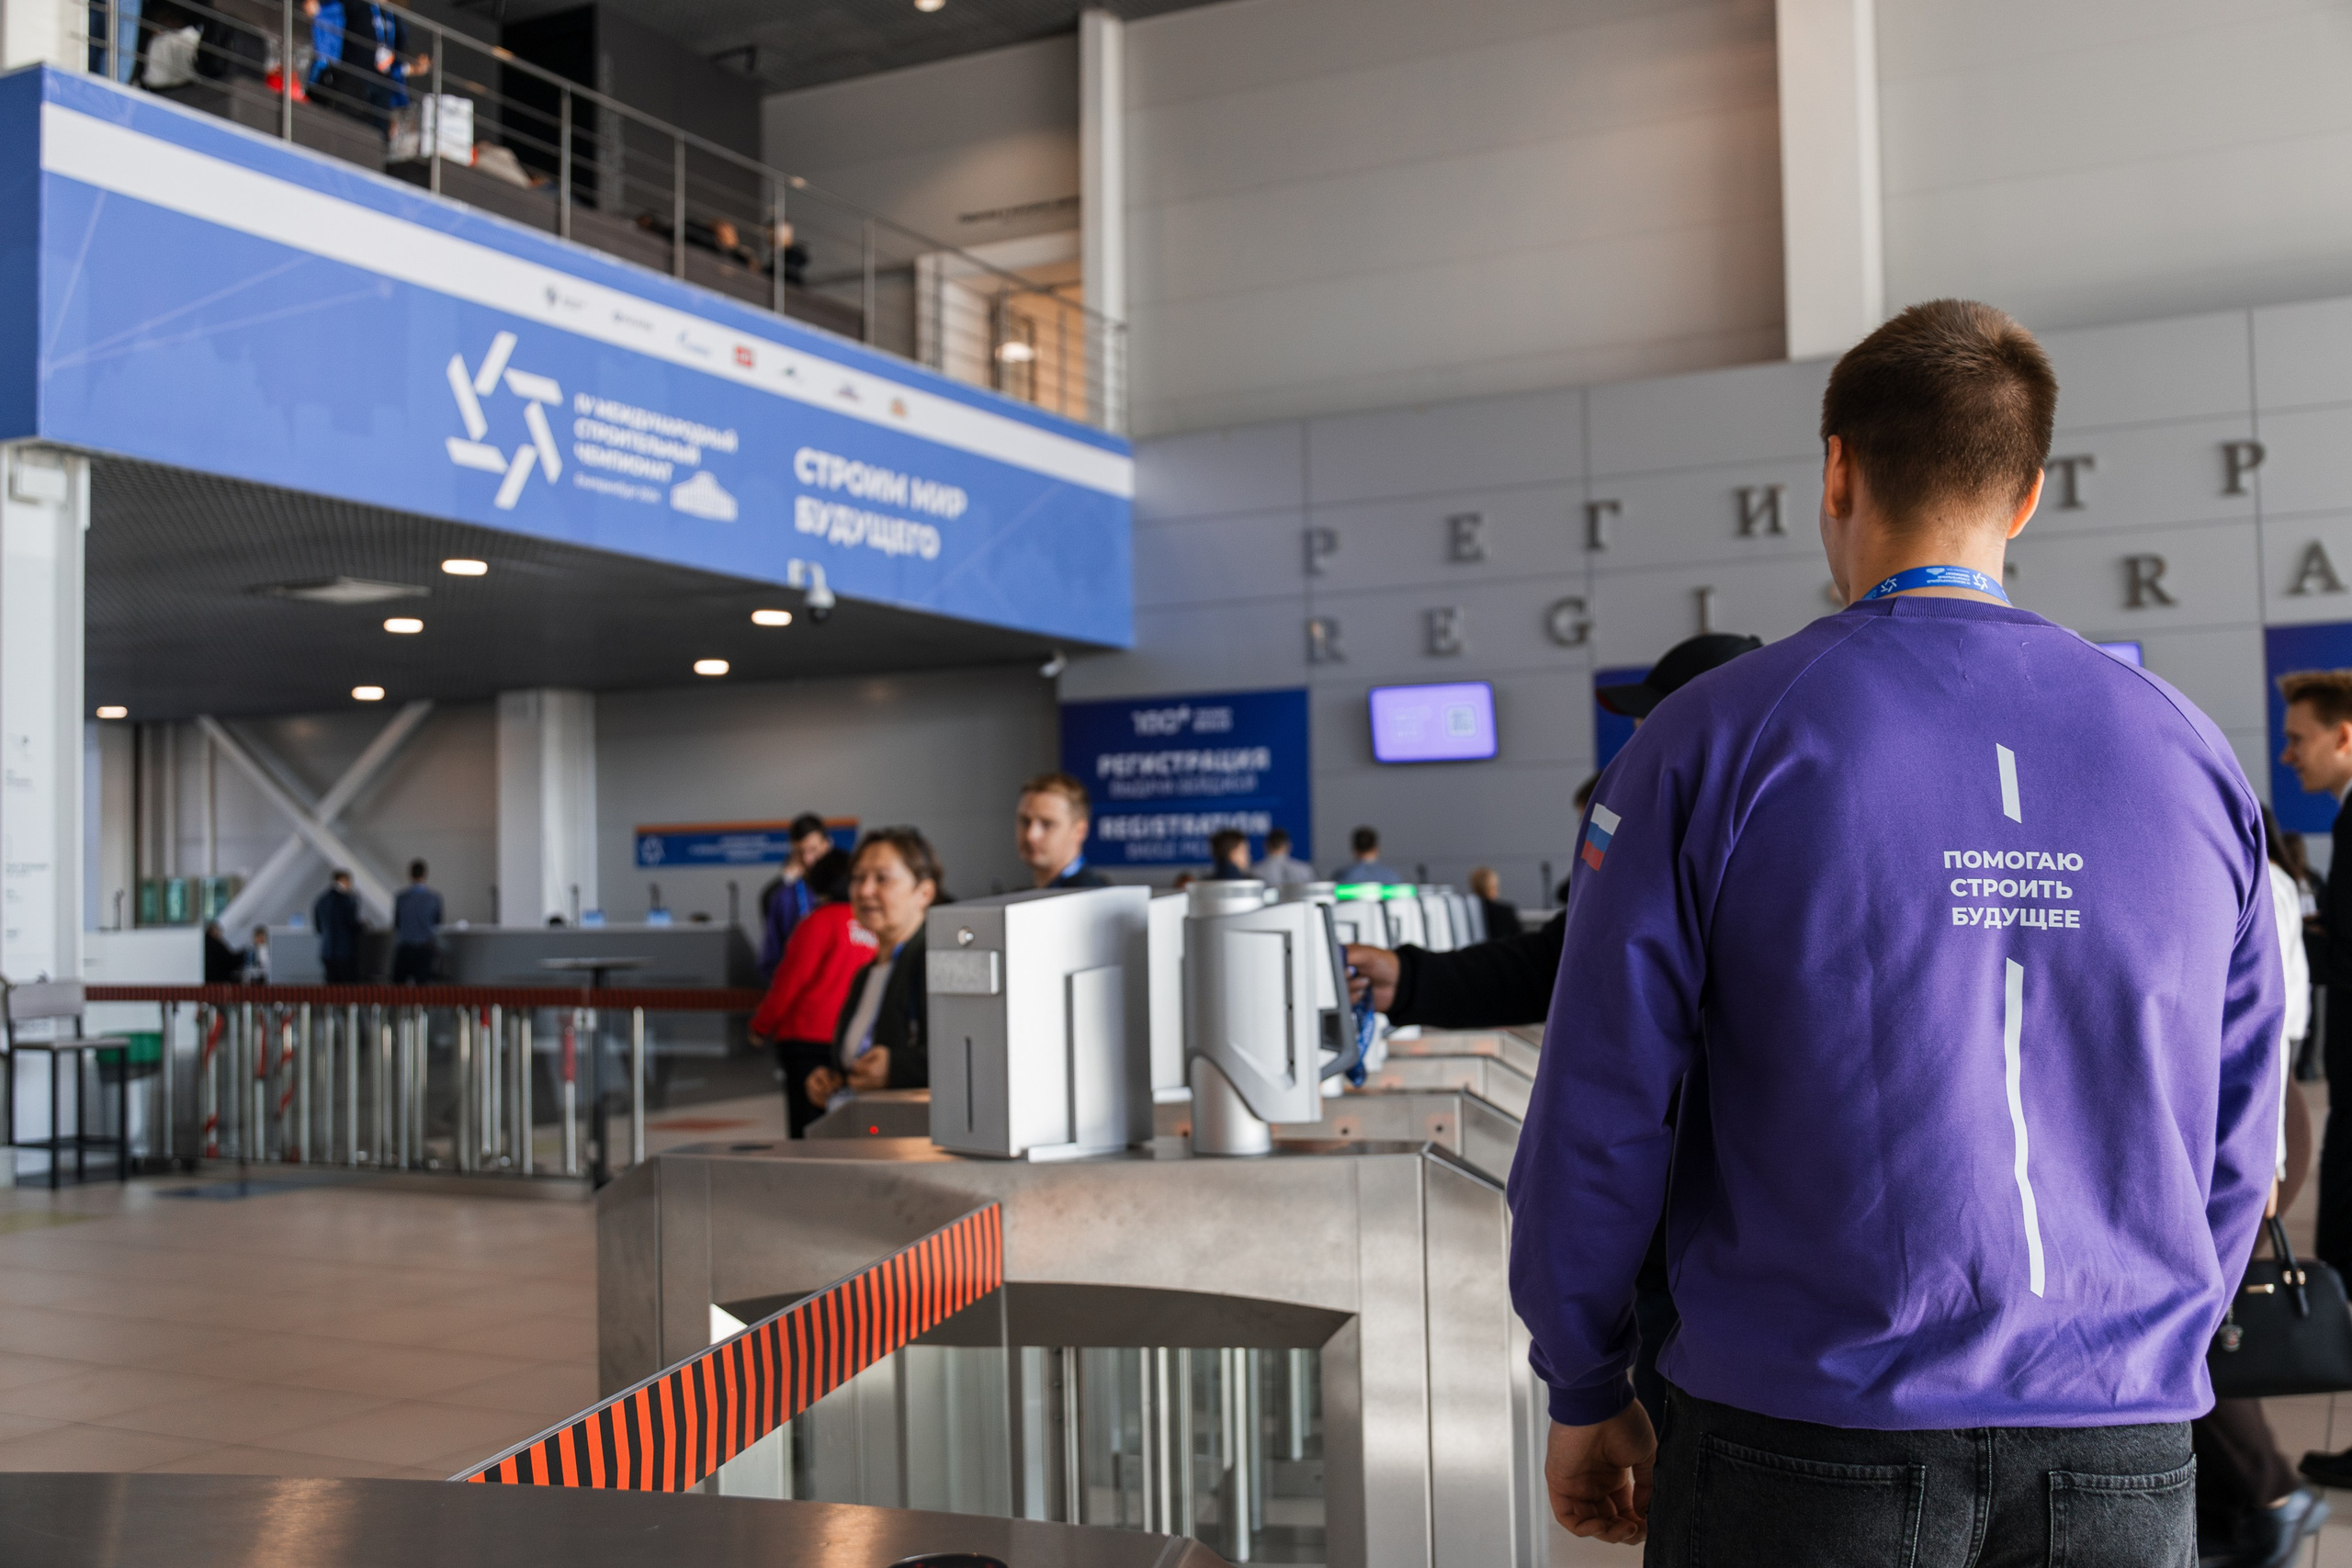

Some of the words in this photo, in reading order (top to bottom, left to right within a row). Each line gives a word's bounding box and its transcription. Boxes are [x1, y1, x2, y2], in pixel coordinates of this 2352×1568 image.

[794, 447, 908, 508] СТРОИМ
[910, 477, 967, 519] МИР
[1302, 439, 2267, 577] РЕГИТР
[795, 495, 941, 560] БУДУЩЕГО
[1097, 747, 1270, 778] РЕГИСТРАЦИЯ
[1943, 851, 2084, 871] ПОМОГАЮ
[1951, 878, 2073, 899] СТРОИТЬ
[1951, 907, 2081, 931] БУДУЩЕЕ
